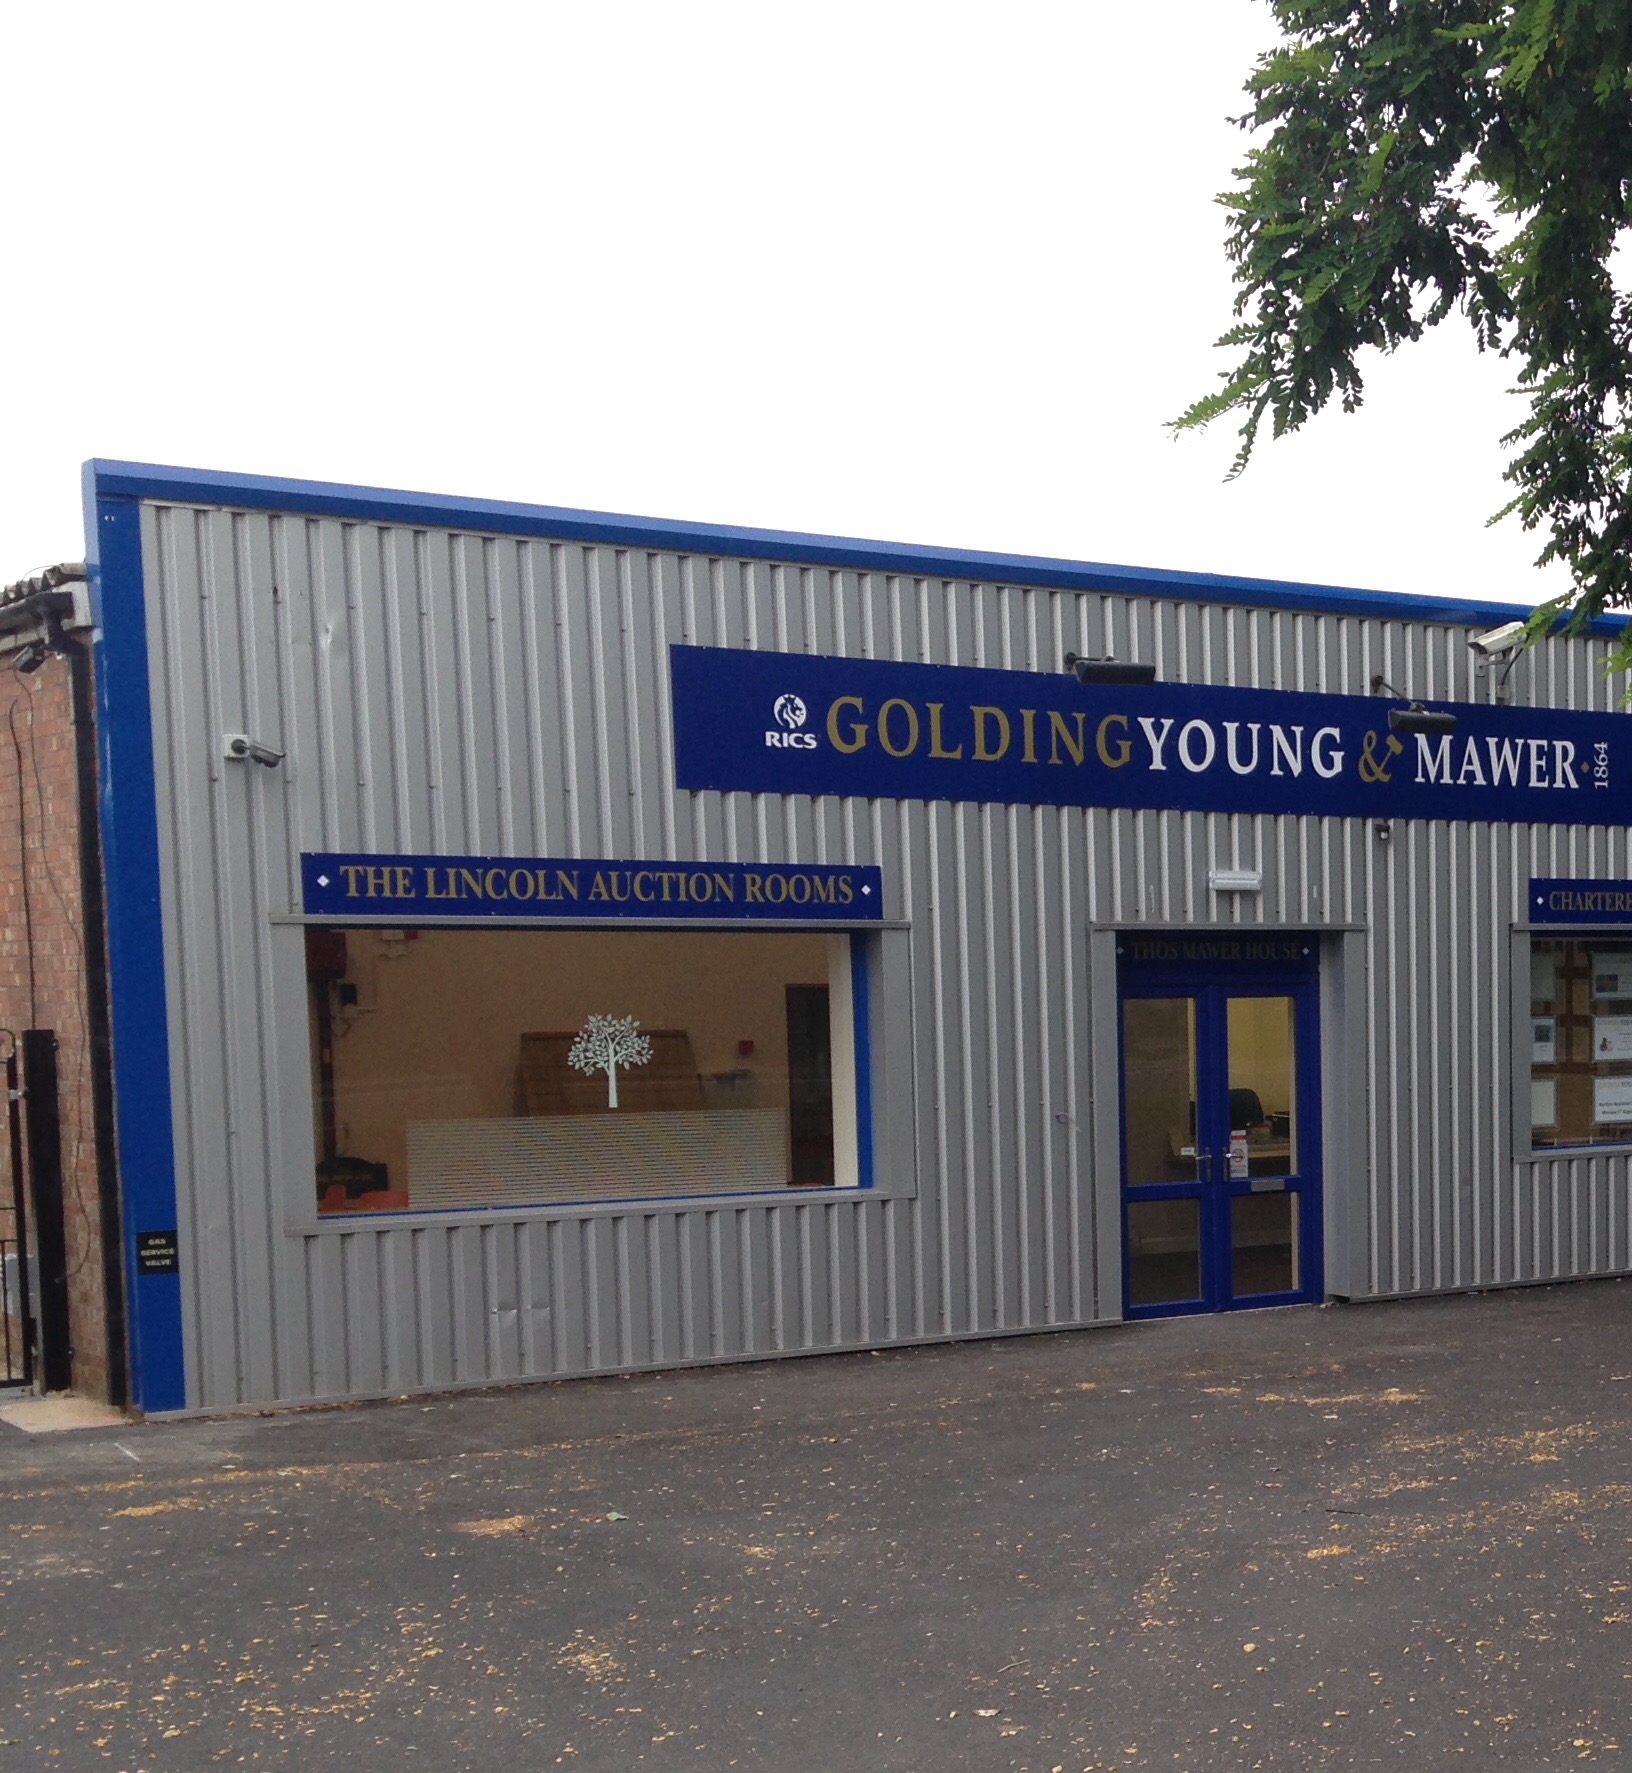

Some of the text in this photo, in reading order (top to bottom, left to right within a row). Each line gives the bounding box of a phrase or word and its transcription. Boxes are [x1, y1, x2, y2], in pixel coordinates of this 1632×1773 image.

[765, 731, 818, 749] RICS
[826, 696, 1133, 768] GOLDING
[1137, 716, 1345, 778] YOUNG
[1414, 733, 1579, 789] MAWER
[1594, 741, 1609, 789] 1864
[339, 865, 854, 904] THE LINCOLN AUCTION ROOMS
[1135, 943, 1301, 960] THOS MAWER HOUSE
